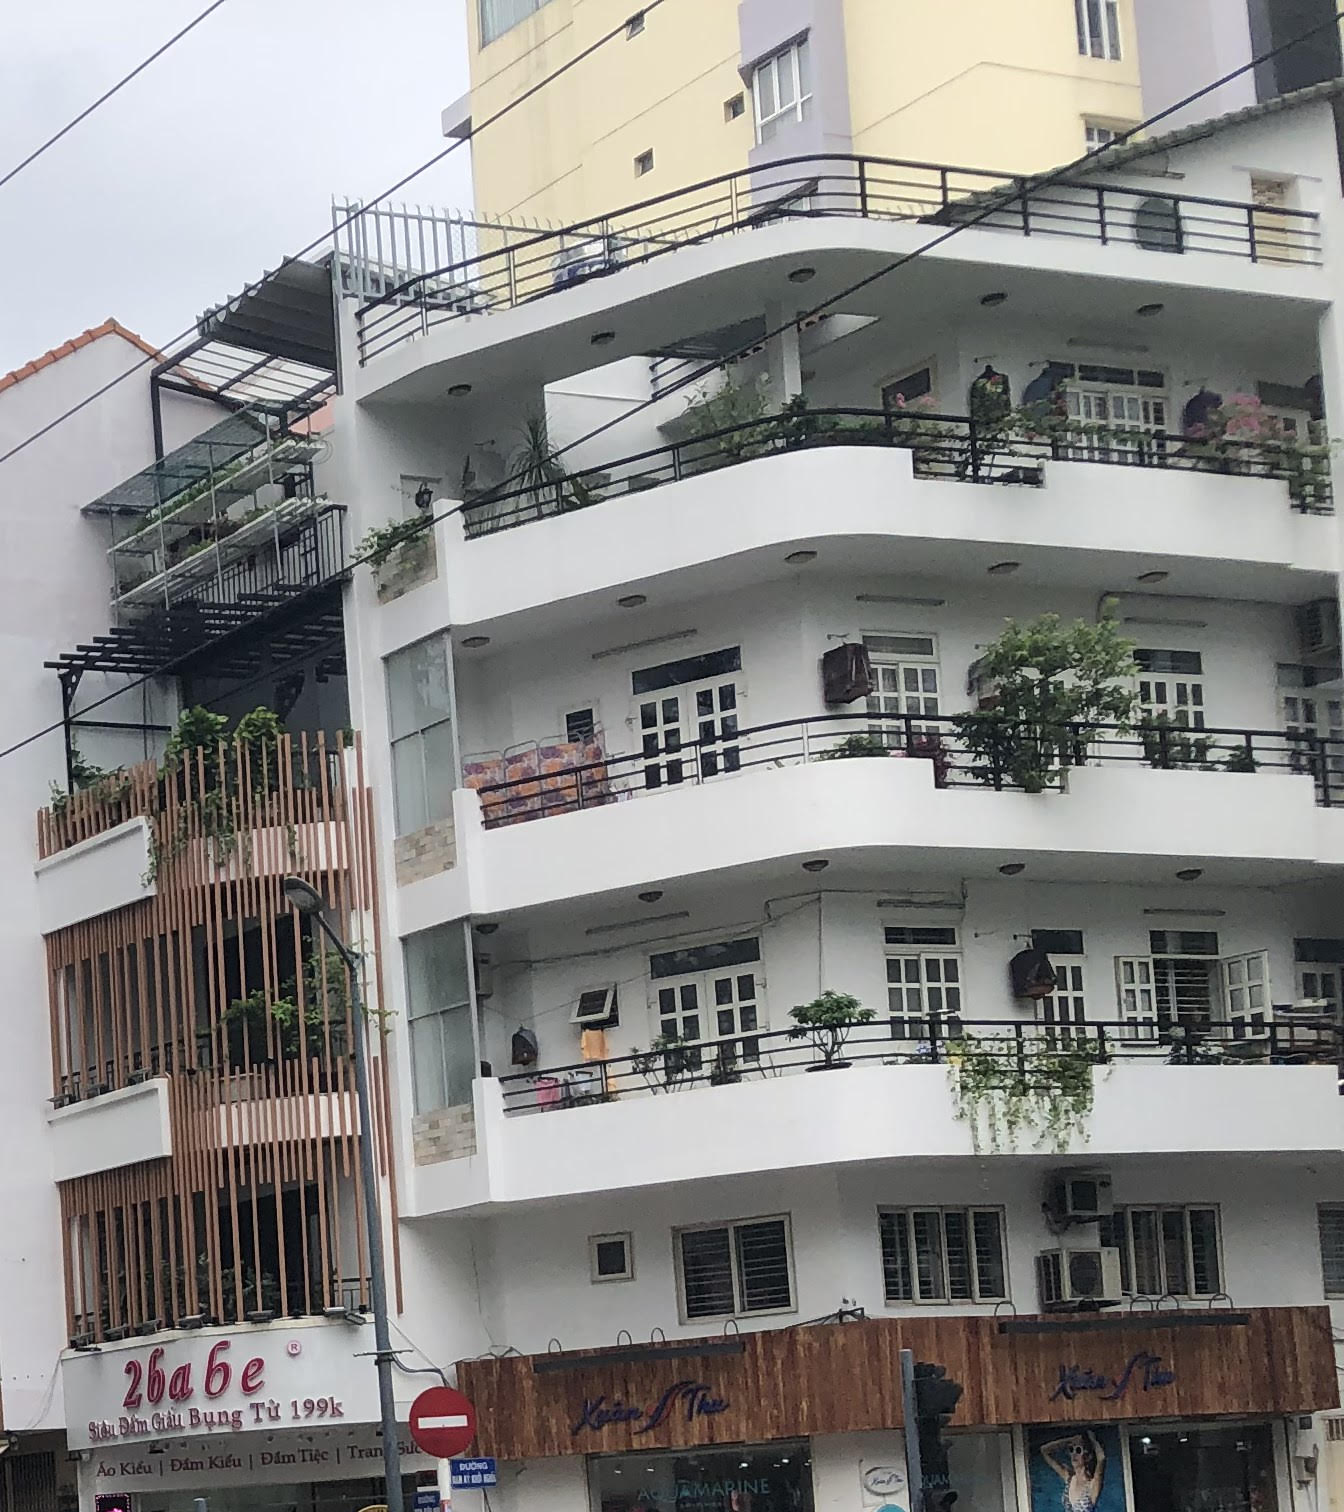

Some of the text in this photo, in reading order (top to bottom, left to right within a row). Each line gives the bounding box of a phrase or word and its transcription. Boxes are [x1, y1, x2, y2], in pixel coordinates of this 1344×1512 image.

[187, 1406, 245, 1432] Bụng
[290, 1395, 345, 1420] 199k
[97, 1461, 116, 1477] Áo
